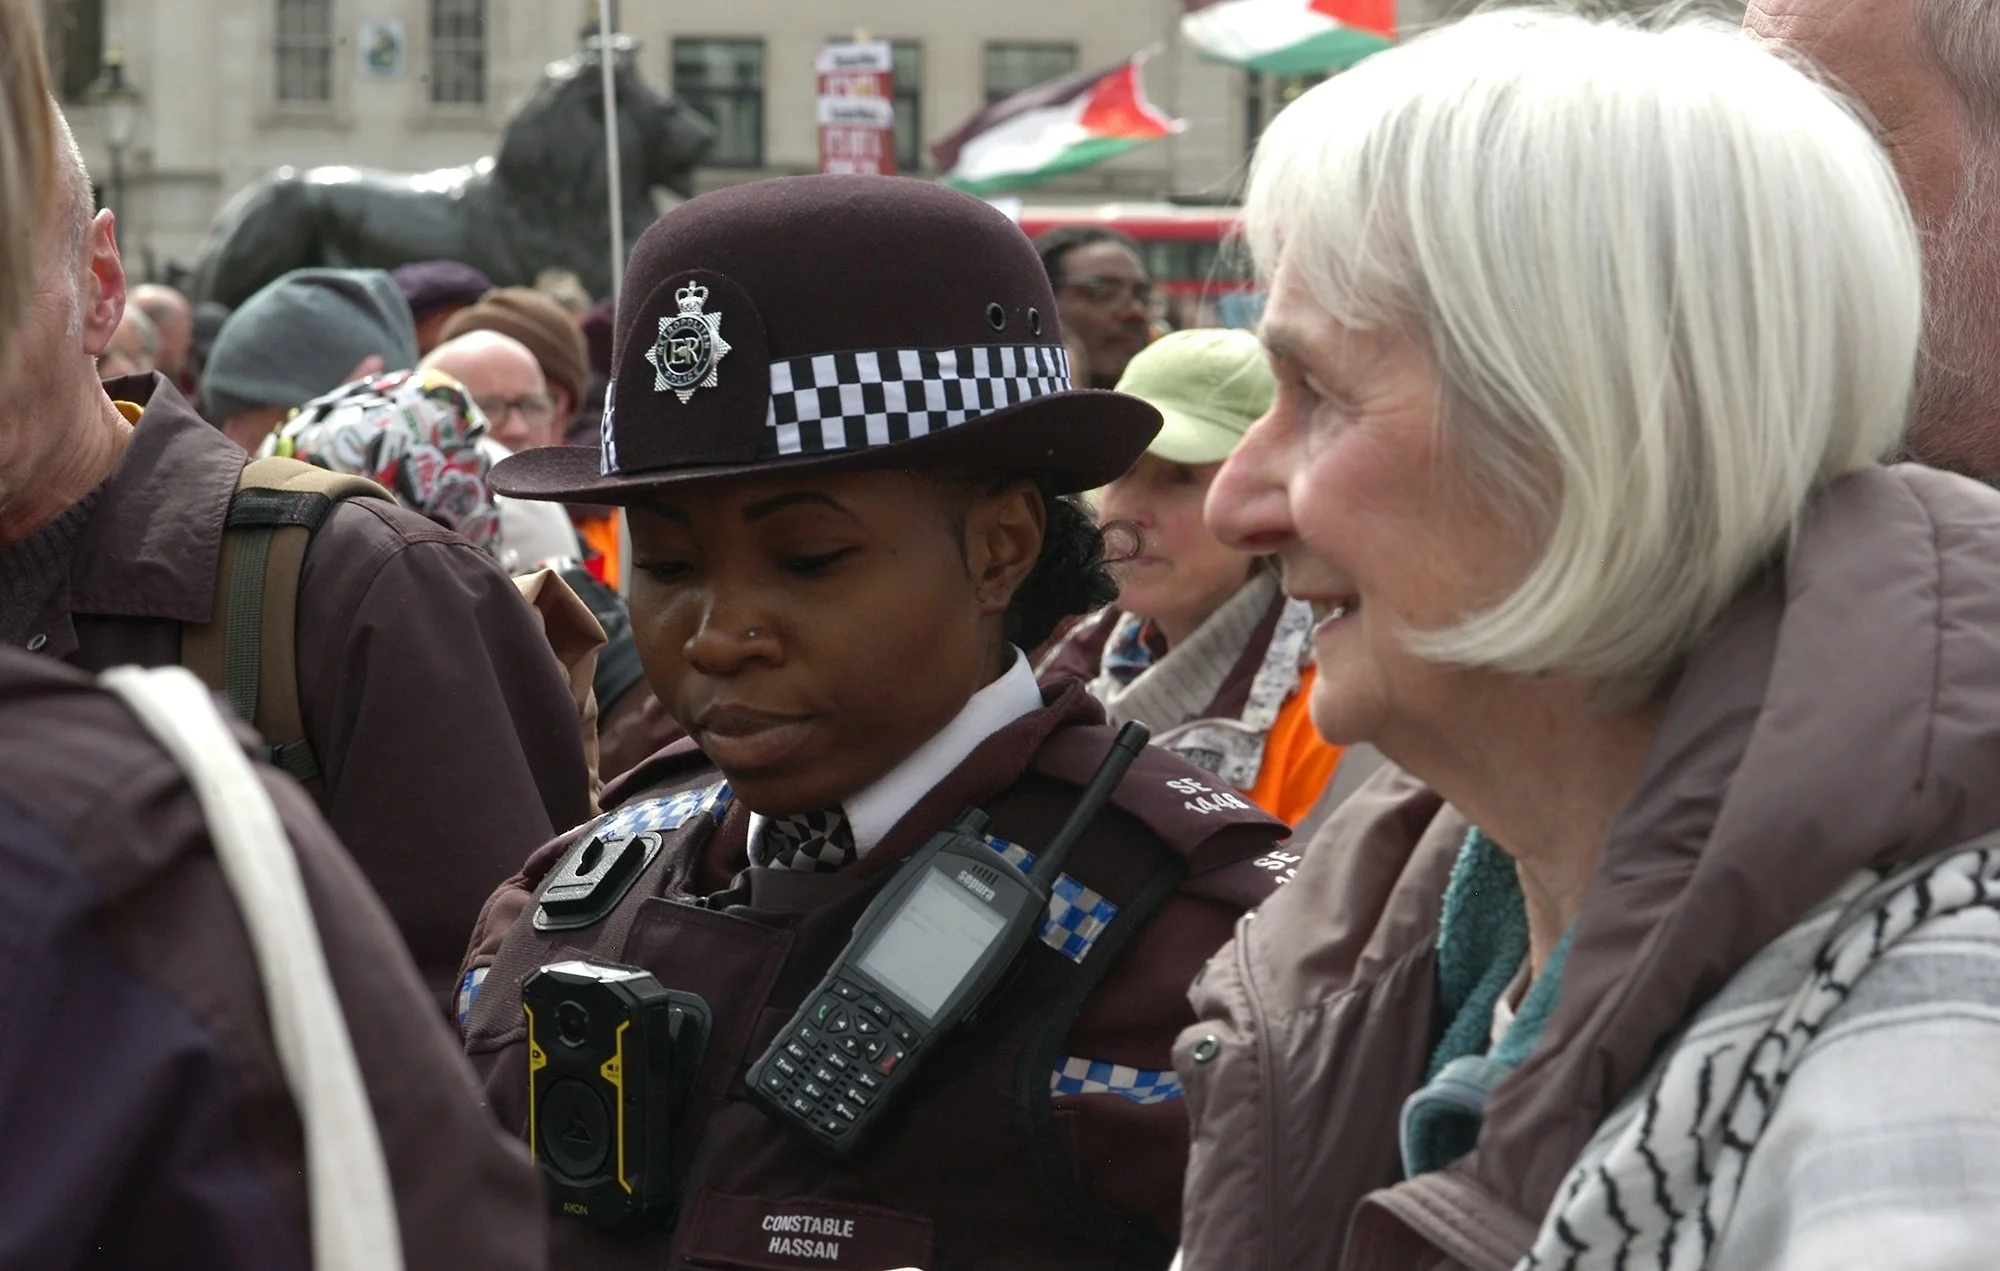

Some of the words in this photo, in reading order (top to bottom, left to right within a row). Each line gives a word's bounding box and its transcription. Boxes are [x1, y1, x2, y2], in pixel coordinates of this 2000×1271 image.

[664, 368, 699, 383] POLICE
[1166, 778, 1213, 795] SE
[1252, 851, 1301, 870] SE
[958, 870, 995, 901] sepura
[563, 1202, 588, 1215] AXON
[762, 1215, 854, 1237] CONSTABLE
[768, 1237, 839, 1260] HASSAN
